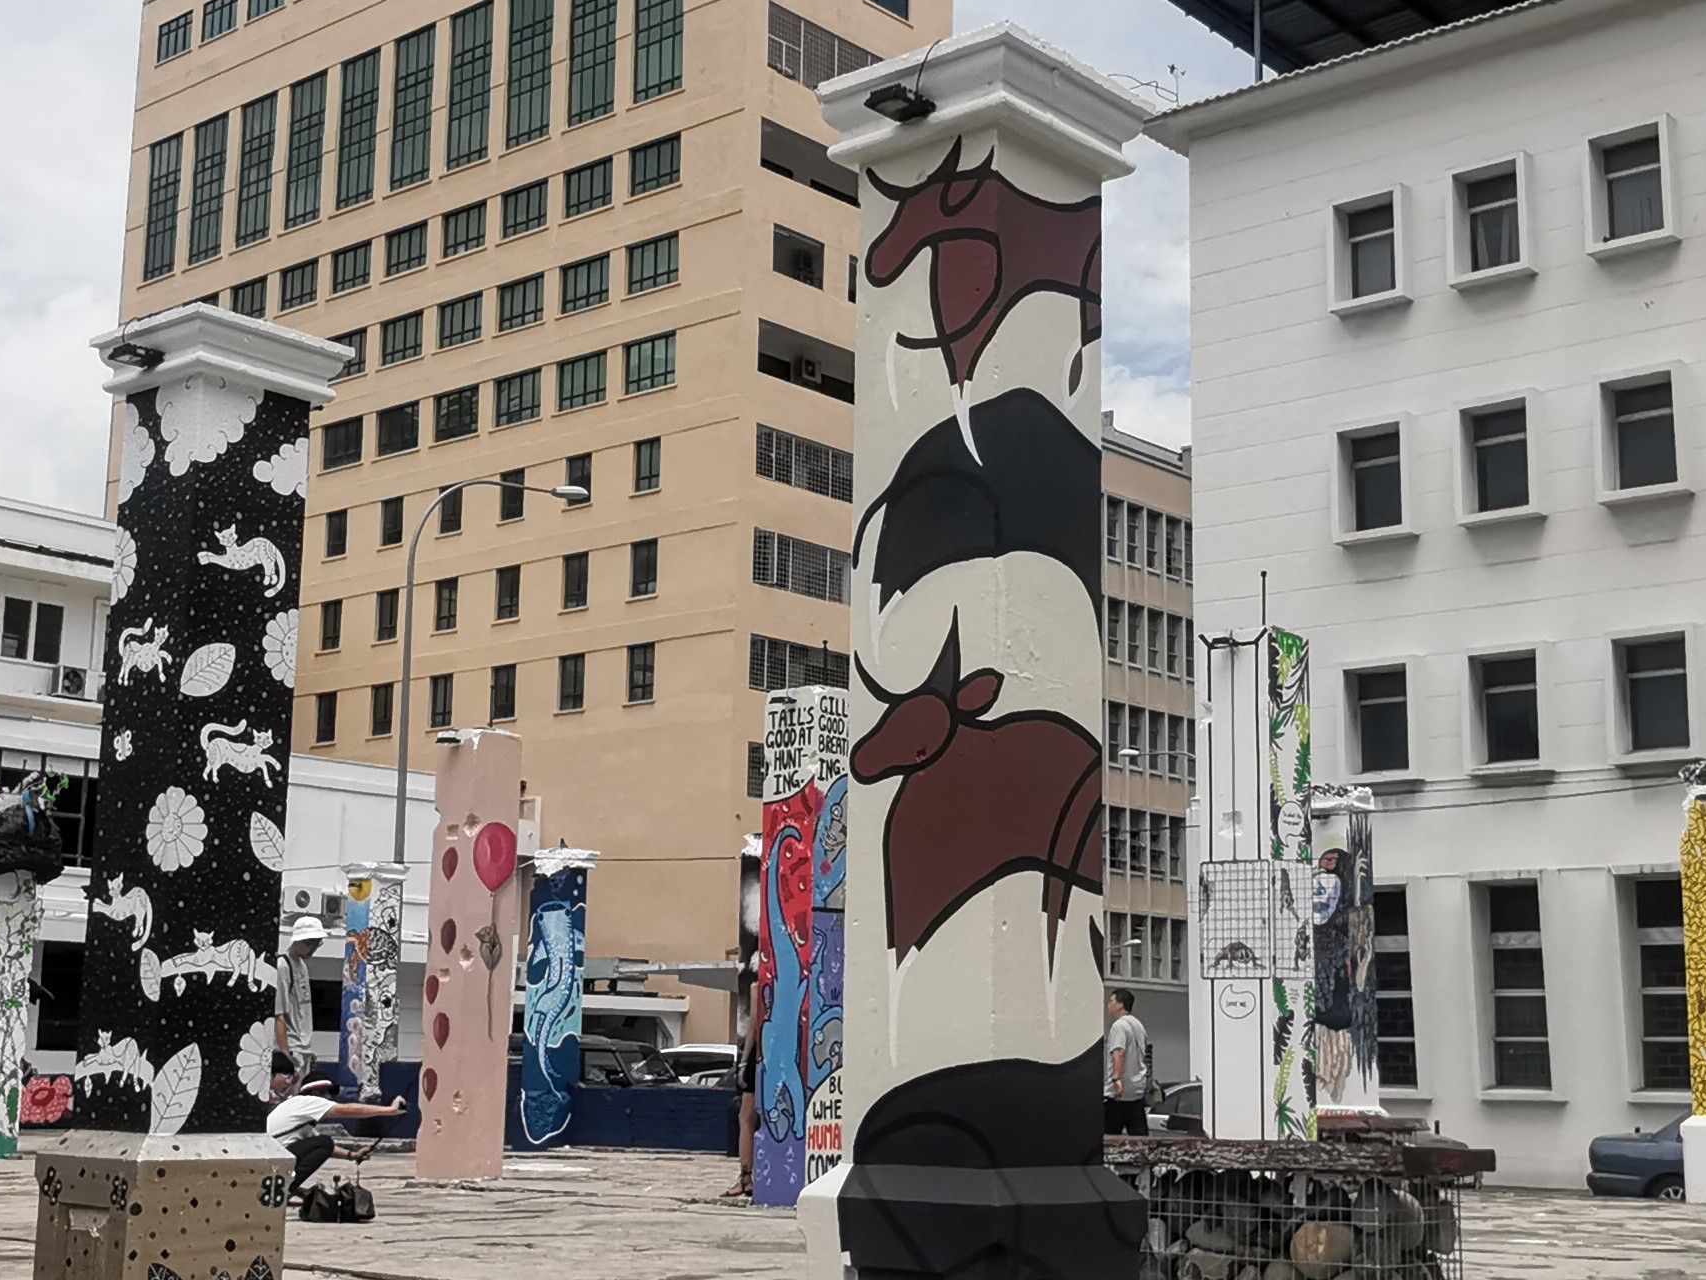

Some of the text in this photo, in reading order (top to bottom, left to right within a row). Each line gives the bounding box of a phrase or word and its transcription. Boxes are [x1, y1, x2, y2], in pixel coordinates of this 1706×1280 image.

[768, 706, 814, 730] TAIL'S
[819, 695, 849, 718] GILL
[818, 715, 845, 736] GOOD
[766, 726, 814, 749] GOOD AT
[817, 758, 845, 781] ING.
[773, 770, 804, 795] ING.
[807, 1123, 843, 1151] HUMA
